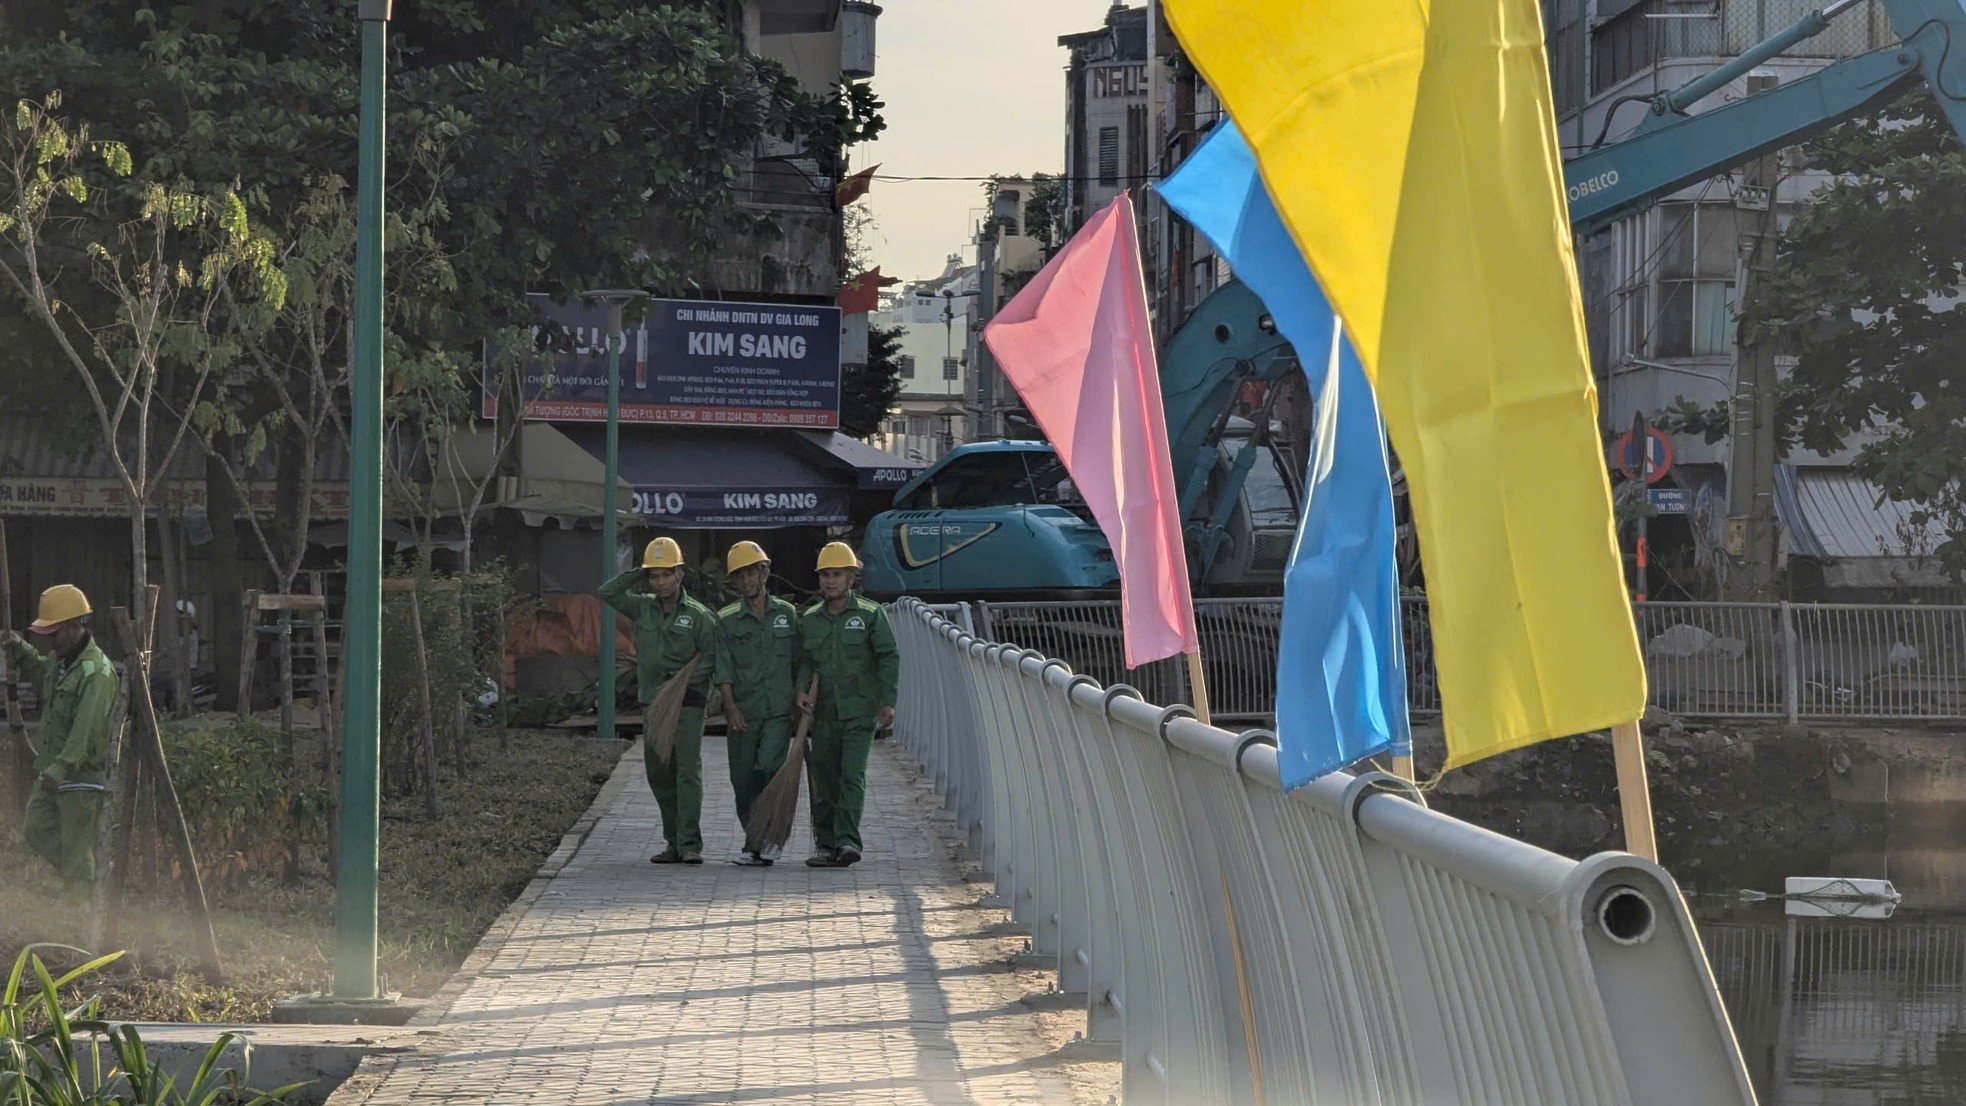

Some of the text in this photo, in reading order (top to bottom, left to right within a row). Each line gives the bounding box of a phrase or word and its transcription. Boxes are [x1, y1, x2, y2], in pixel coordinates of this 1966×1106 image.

[1566, 170, 1619, 203] OBELCO
[677, 308, 693, 321] CHI
[775, 313, 792, 326] GIA
[794, 314, 819, 327] LONG
[688, 331, 807, 359] KIM SANG
[873, 469, 907, 482] APOLLO
[723, 493, 818, 510] KIM SANG
[910, 525, 961, 536] ACERA
